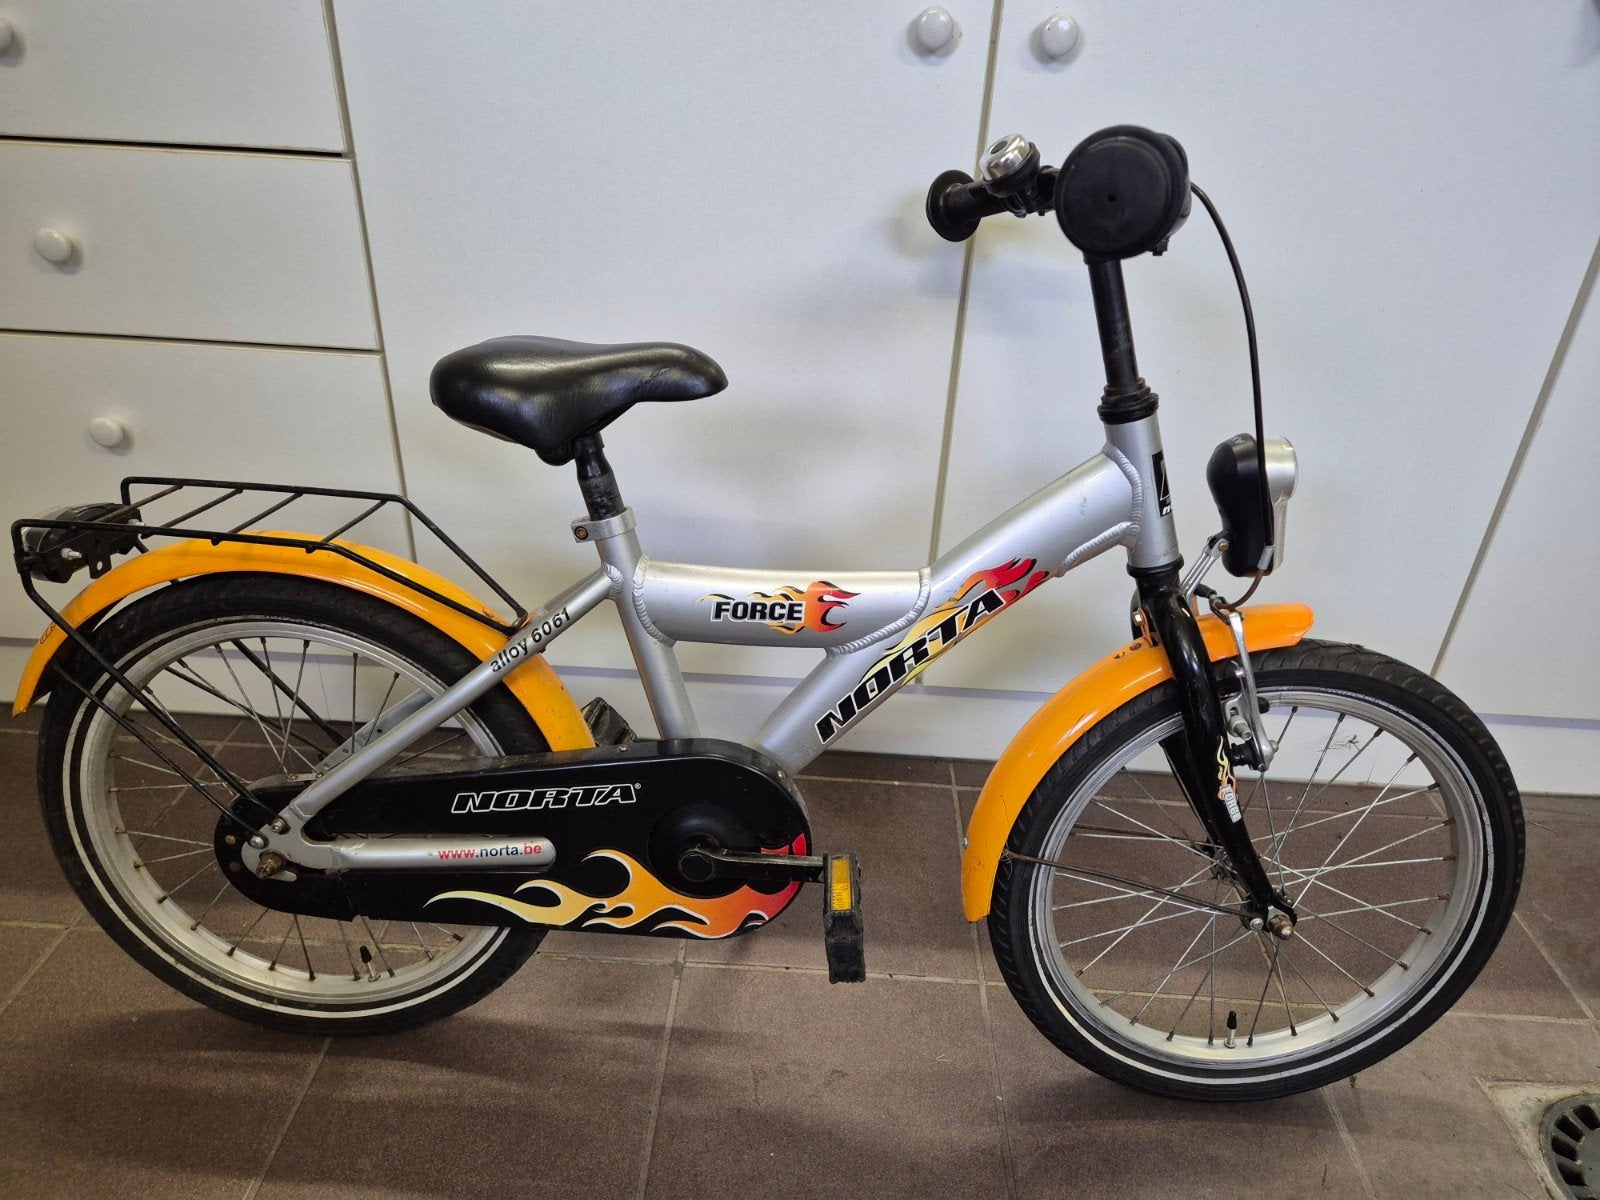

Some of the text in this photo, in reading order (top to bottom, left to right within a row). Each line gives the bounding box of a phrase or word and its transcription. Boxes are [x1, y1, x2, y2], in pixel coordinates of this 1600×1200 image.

[710, 600, 806, 622] FORCE
[490, 606, 571, 673] alloy 6061
[815, 588, 1006, 744] NORTA
[438, 842, 542, 860] www.norta.be
